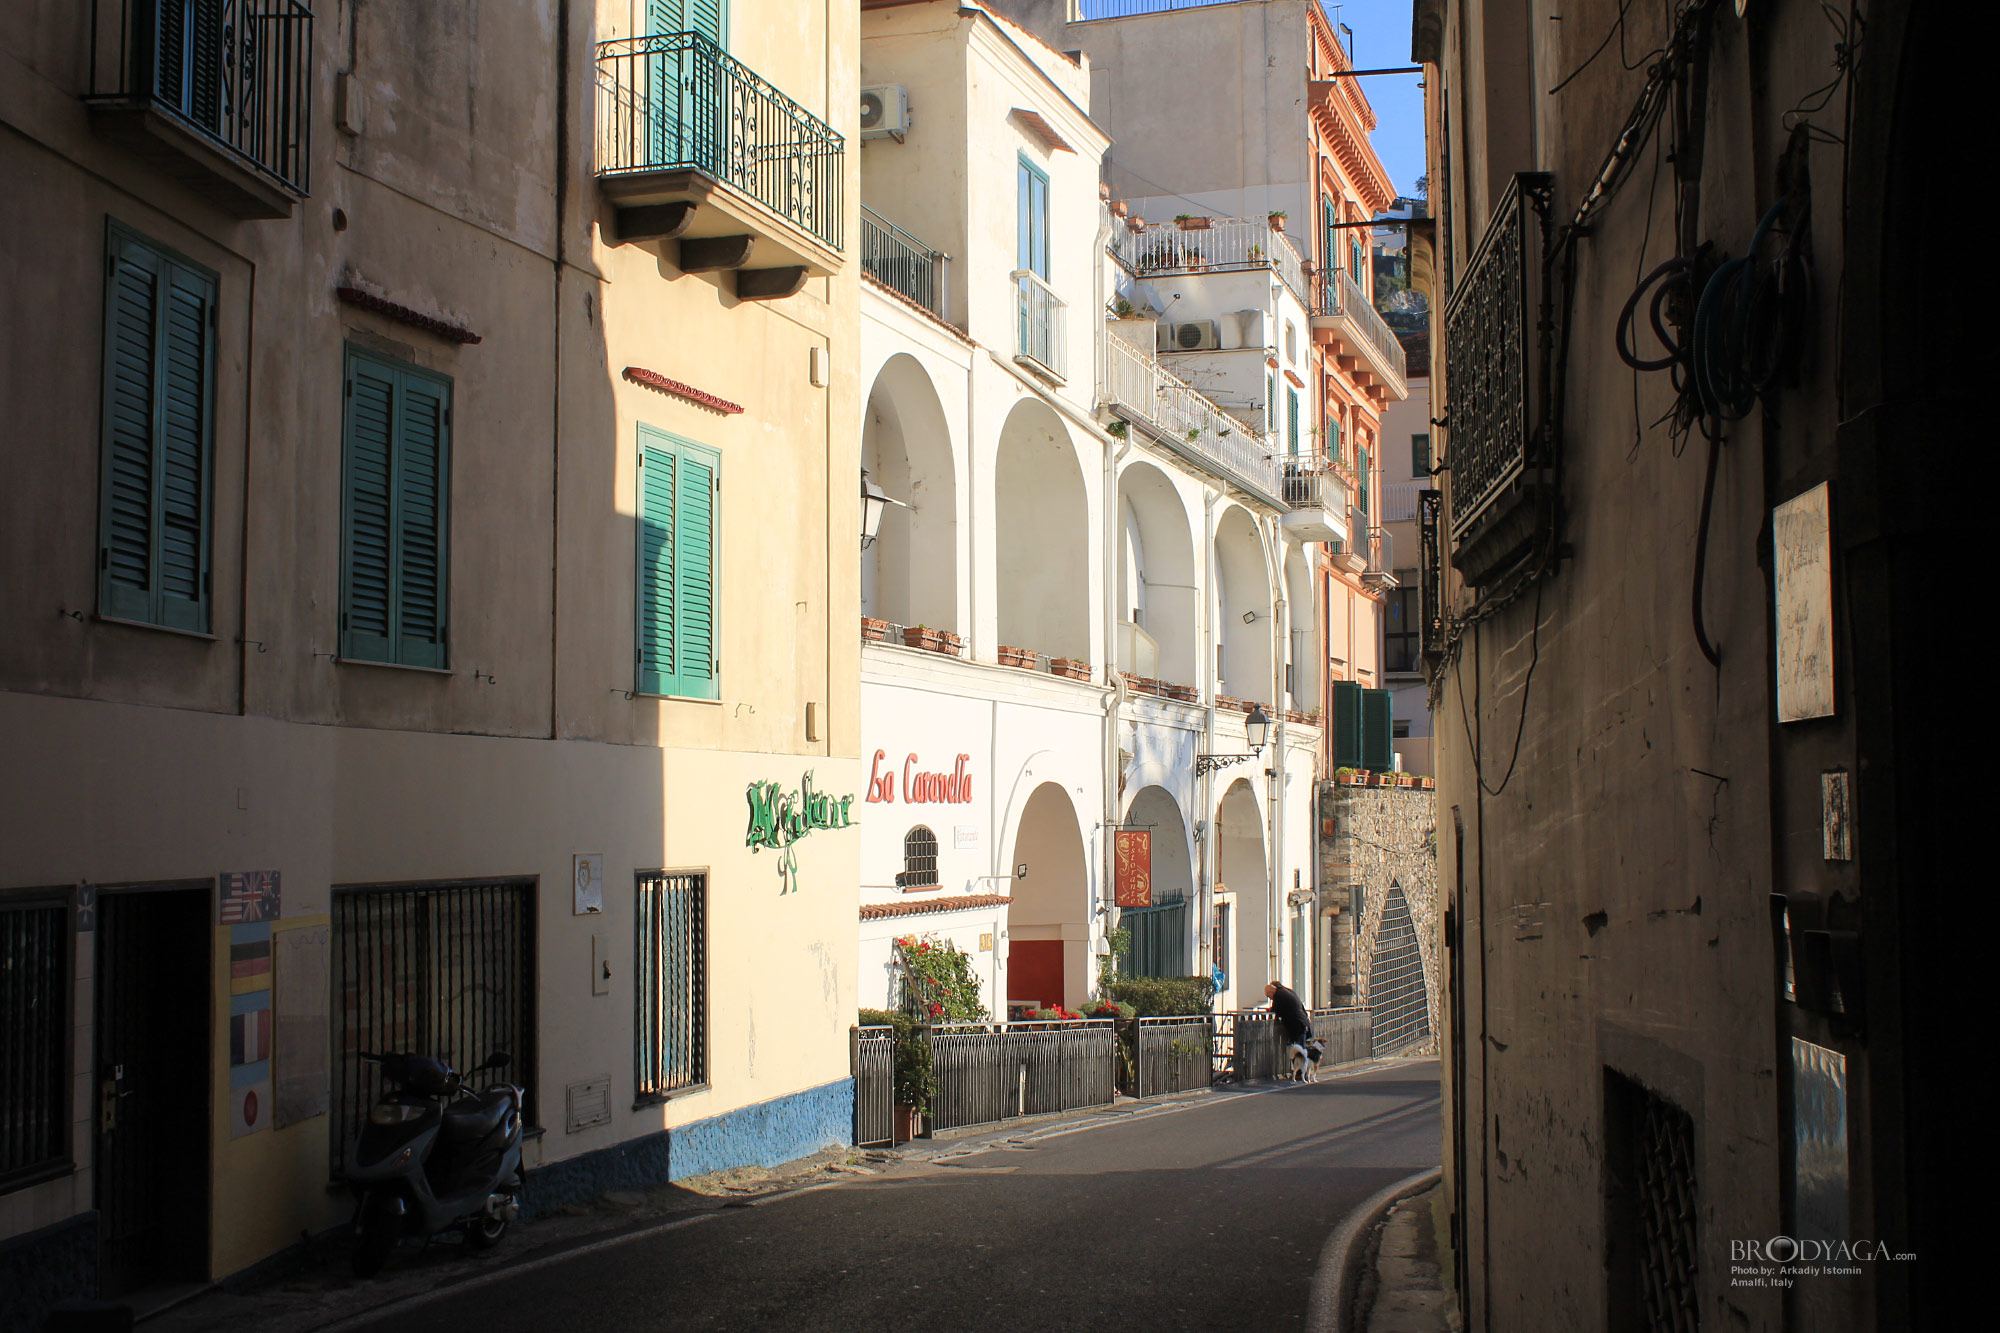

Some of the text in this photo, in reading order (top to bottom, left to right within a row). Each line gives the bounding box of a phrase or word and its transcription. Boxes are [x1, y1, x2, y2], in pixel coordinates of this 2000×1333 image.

[866, 749, 972, 803] La Caravella
[1129, 833, 1137, 904] ristorante
